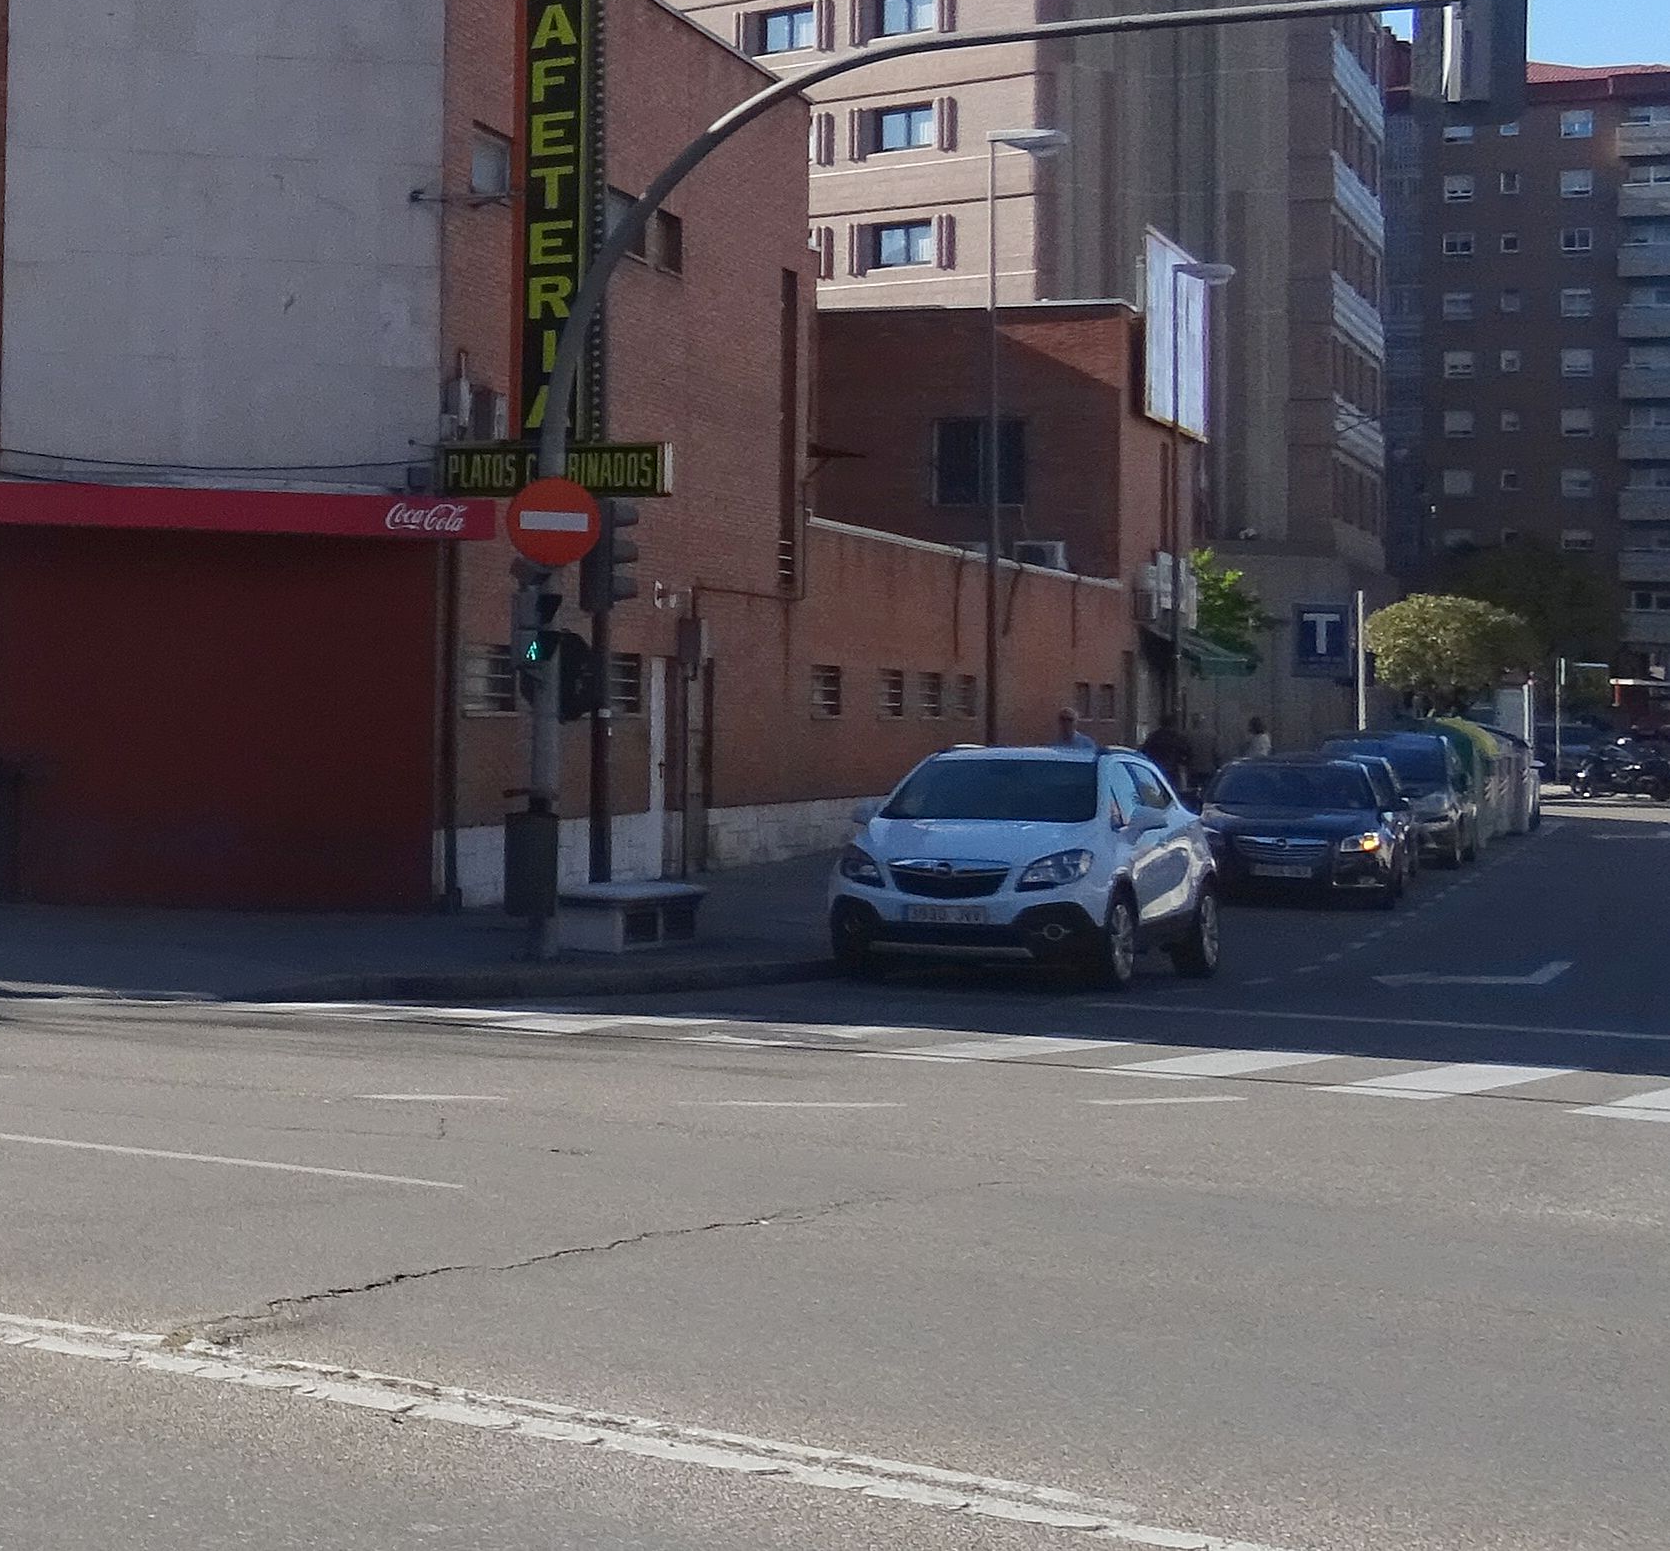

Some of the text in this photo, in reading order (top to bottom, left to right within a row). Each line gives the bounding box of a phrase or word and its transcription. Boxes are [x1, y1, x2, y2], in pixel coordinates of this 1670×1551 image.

[447, 452, 653, 489] PLATOS CBINADOS
[1303, 612, 1341, 655] T
